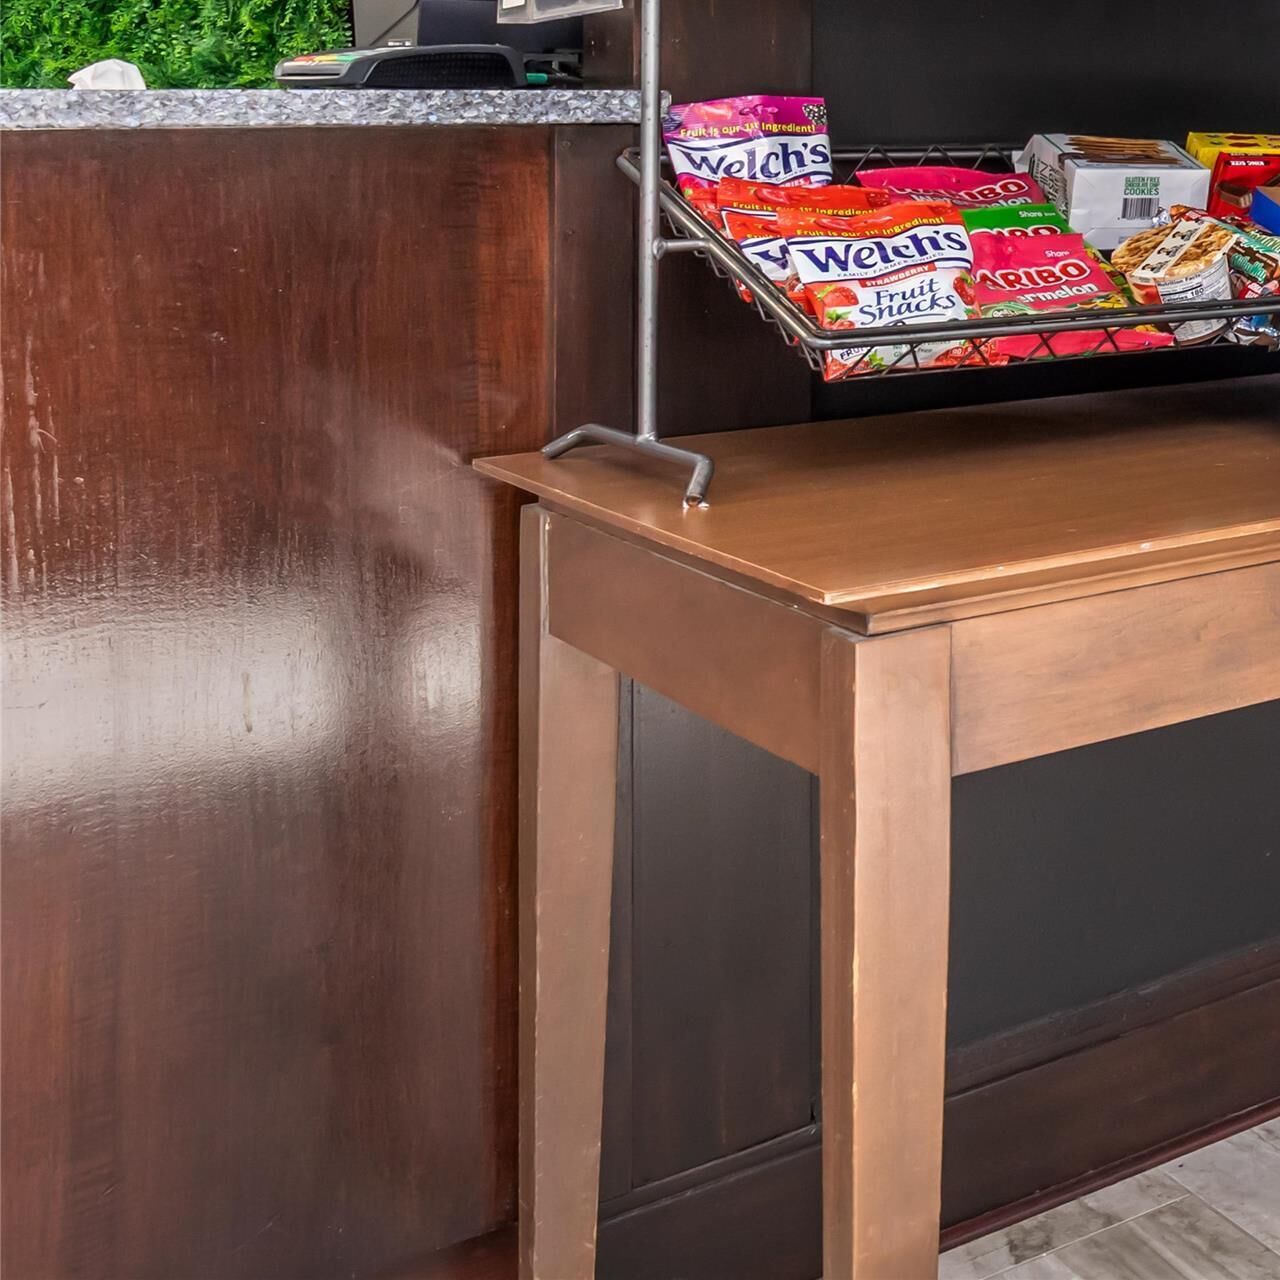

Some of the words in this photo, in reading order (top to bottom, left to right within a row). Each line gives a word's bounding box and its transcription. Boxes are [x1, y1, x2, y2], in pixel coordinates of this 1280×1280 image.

[680, 126, 705, 138] Fruit
[709, 126, 719, 136] is
[722, 124, 741, 135] our
[745, 122, 759, 132] 1st
[761, 121, 816, 134] Ingredient!
[676, 141, 830, 182] Welch's
[1124, 188, 1159, 196] COOKIES
[733, 201, 760, 211] Fruit
[1018, 210, 1042, 218] Share
[797, 229, 823, 237] Fruit
[882, 217, 945, 236] Ingredient!
[800, 230, 967, 273] Welch's
[865, 265, 929, 287] STRAWBERRY
[973, 261, 1090, 292] ARIBO
[875, 277, 940, 307] Fruit
[858, 293, 956, 326] Snacks
